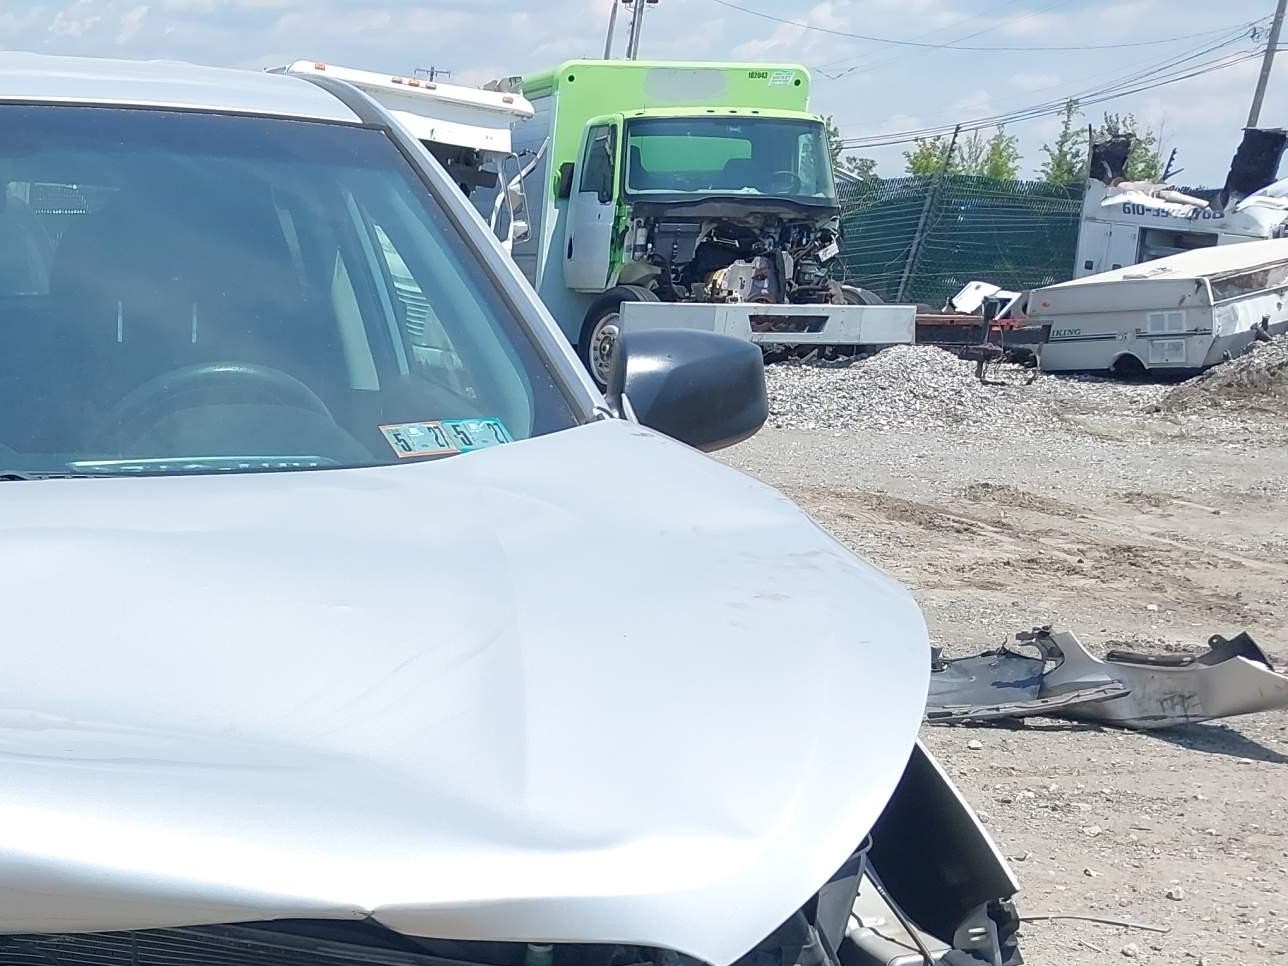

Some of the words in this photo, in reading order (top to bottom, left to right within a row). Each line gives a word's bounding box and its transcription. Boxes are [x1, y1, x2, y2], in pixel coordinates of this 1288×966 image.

[1051, 328, 1081, 337] IKING
[393, 432, 412, 452] 5
[451, 424, 474, 446] 5
